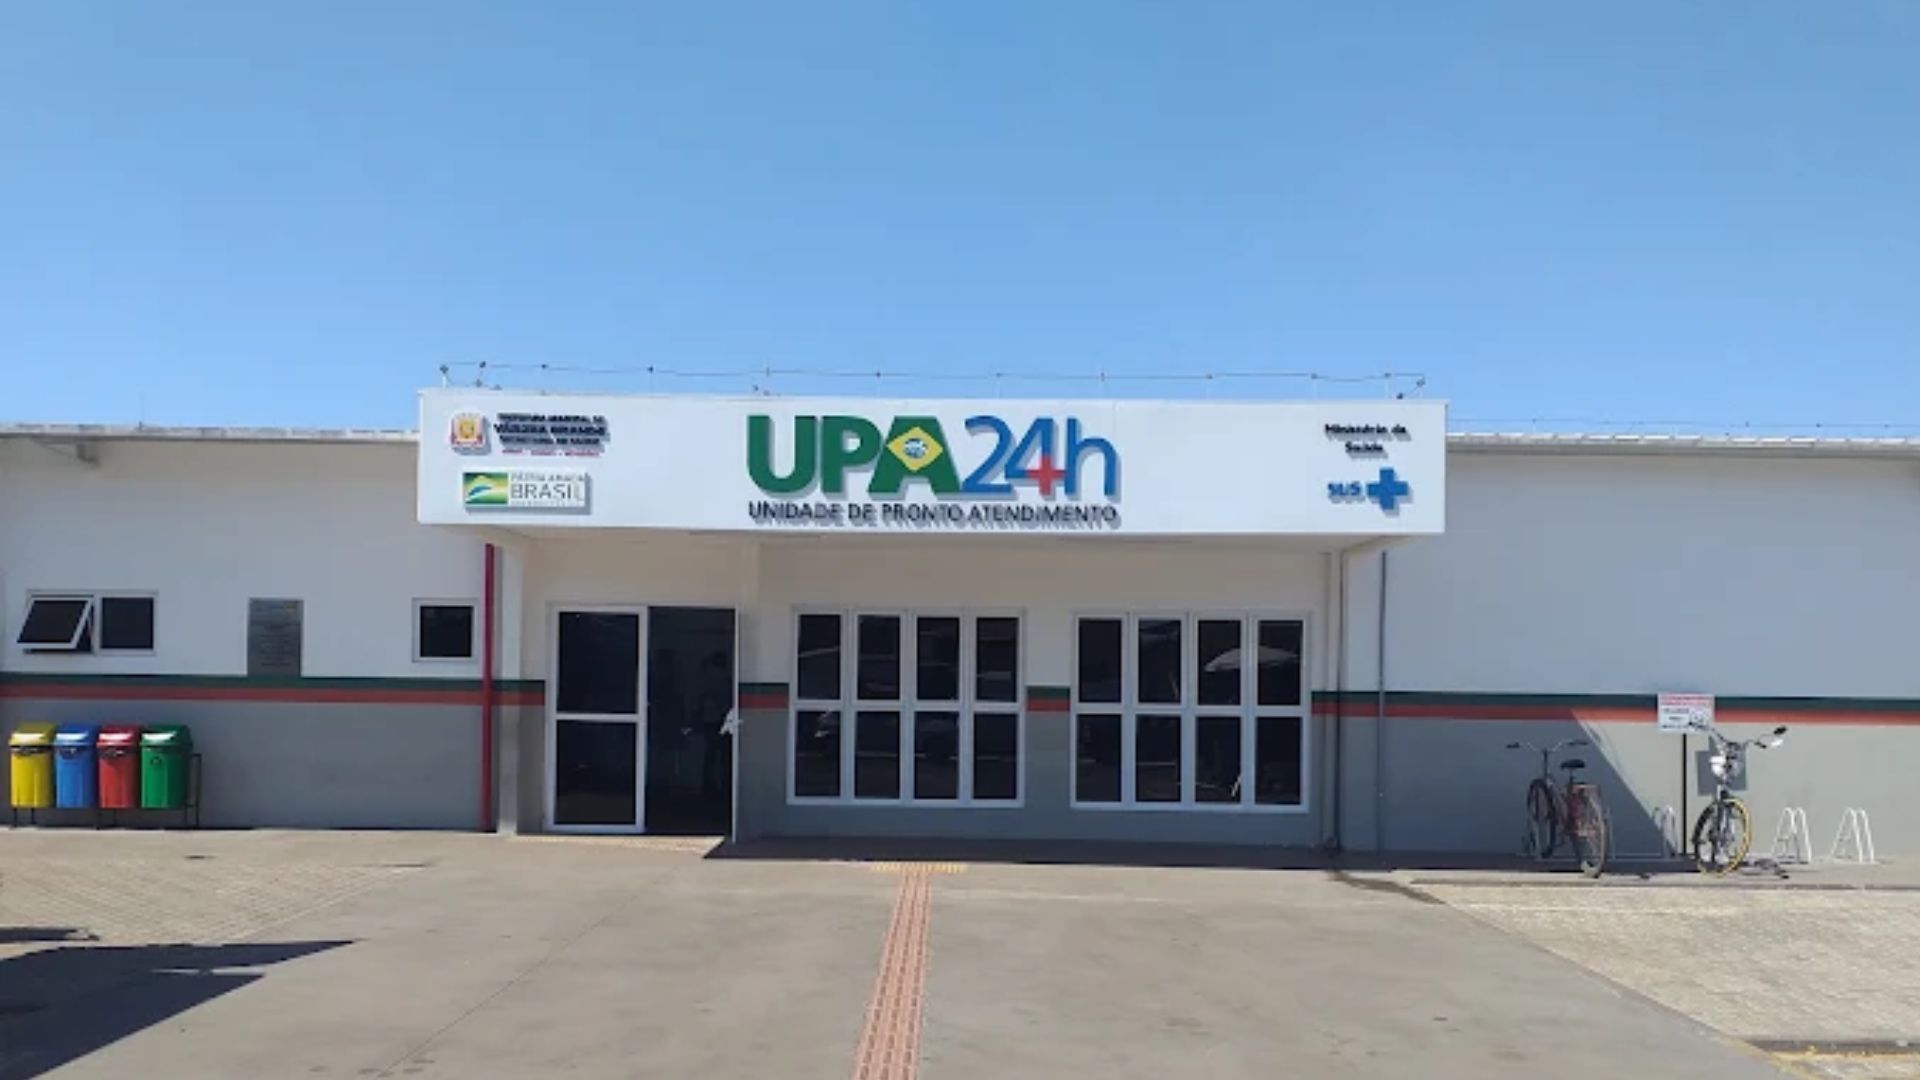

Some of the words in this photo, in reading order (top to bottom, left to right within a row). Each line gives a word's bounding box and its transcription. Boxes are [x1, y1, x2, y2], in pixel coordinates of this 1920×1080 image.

[747, 415, 961, 493] UPA
[961, 415, 1118, 496] 24h
[511, 483, 585, 500] BRASIL
[1328, 481, 1361, 497] SUS
[749, 501, 843, 520] UNIDADE
[848, 503, 874, 521] DE
[882, 503, 962, 522] PRONTO
[967, 504, 1118, 522] ATENDIMENTO
